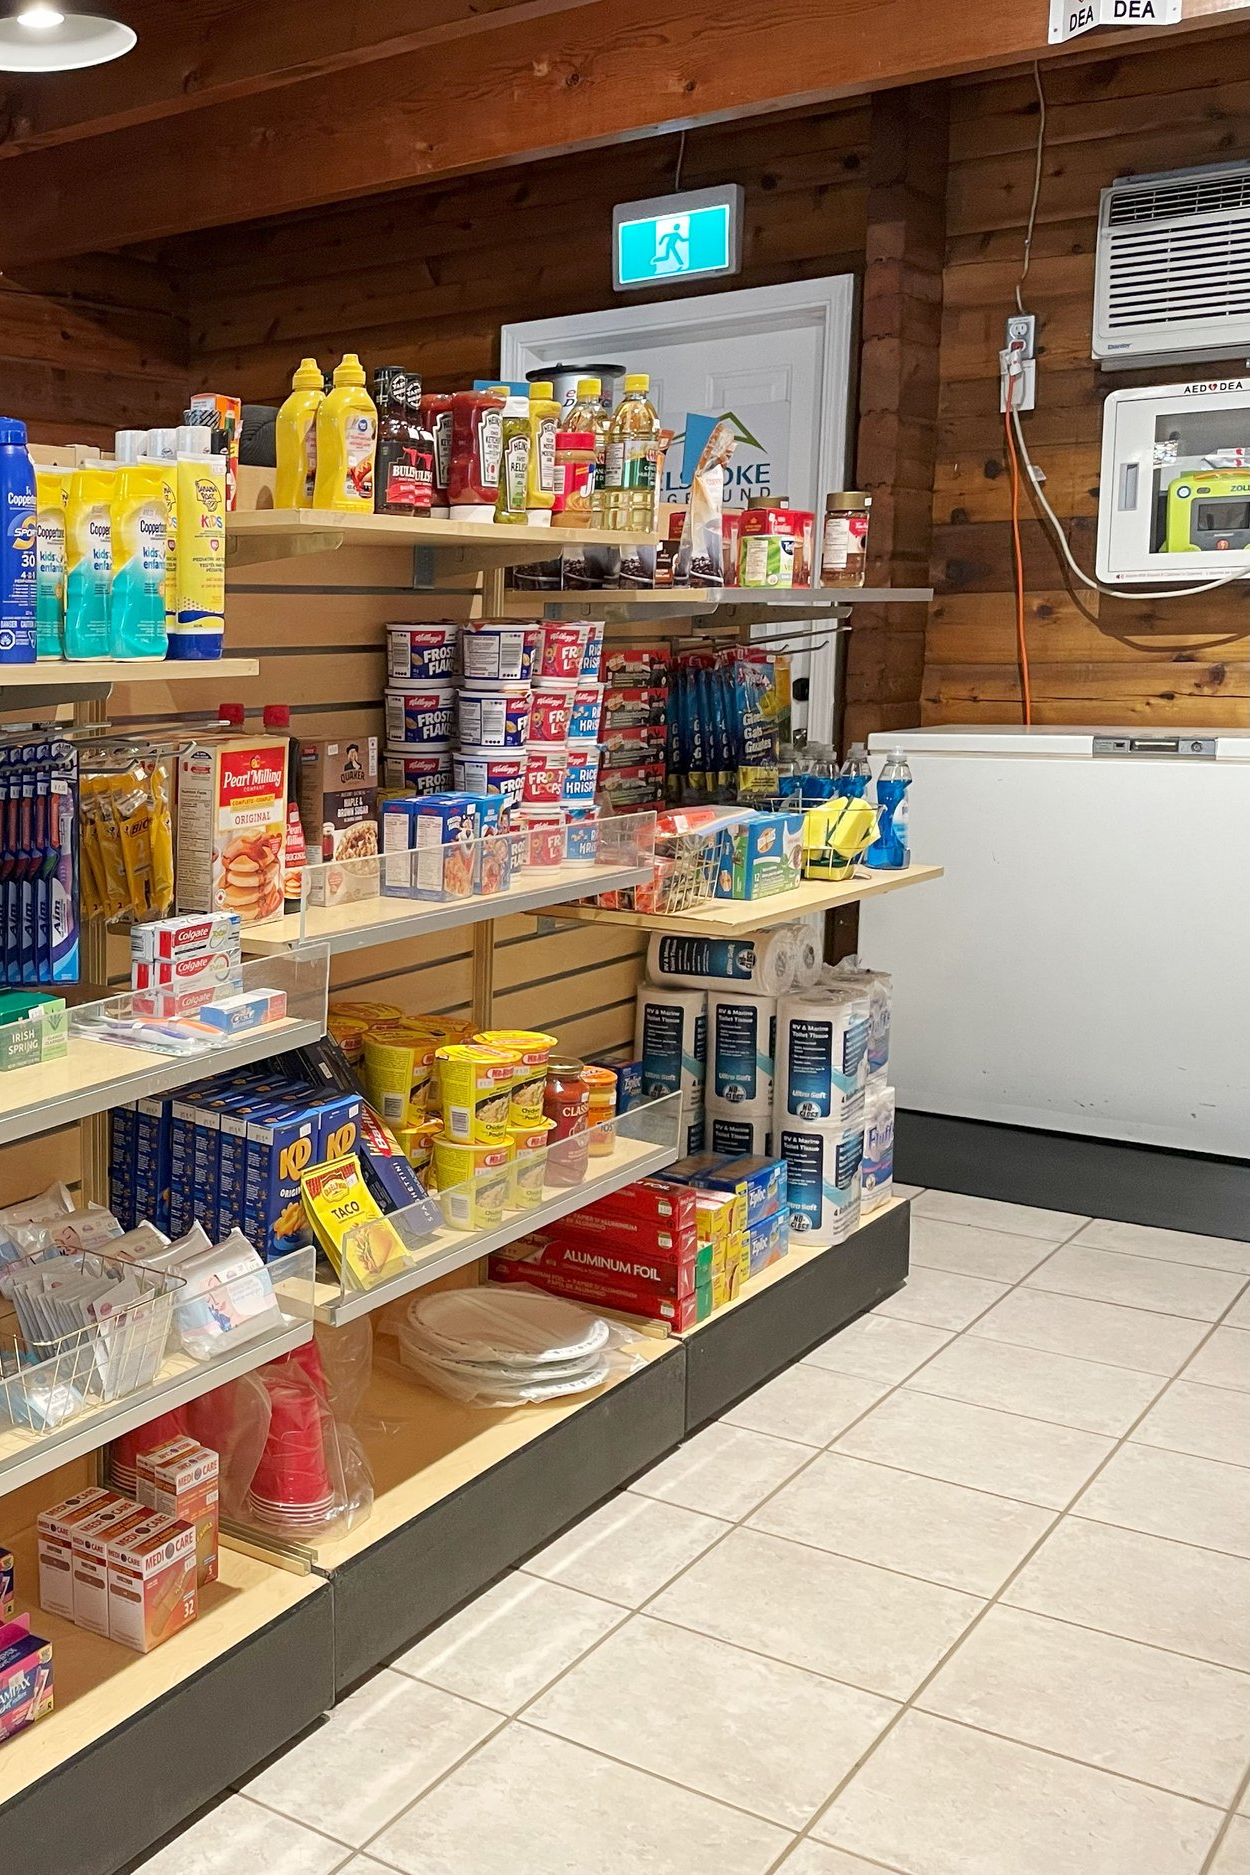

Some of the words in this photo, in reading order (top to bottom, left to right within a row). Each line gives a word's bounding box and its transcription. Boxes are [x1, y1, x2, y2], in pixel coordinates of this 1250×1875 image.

[1069, 6, 1094, 32] DEA
[1114, 0, 1155, 18] DEA
[1184, 384, 1207, 394] AED
[1220, 381, 1243, 391] DEA
[40, 551, 55, 561] kids
[93, 549, 109, 560] kids
[143, 547, 159, 559] kids
[21, 554, 35, 567] 30
[415, 633, 442, 643] Kellogg's
[550, 632, 577, 643] Kellogg's
[409, 699, 436, 709] Kellogg's
[537, 696, 563, 706] Kellogg's
[492, 764, 519, 774] Kellogg's
[223, 770, 250, 788] Pearl
[252, 768, 281, 787] Milling
[341, 771, 365, 783] QUAKER
[235, 812, 270, 825] ORIGINAL
[131, 818, 149, 837] BIC
[53, 900, 62, 934] Aim
[178, 927, 209, 941] Colgate
[178, 958, 208, 972] Colgate
[182, 992, 211, 1007] Colgate
[718, 1015, 733, 1023] Toilet
[12, 1030, 35, 1044] IRISH
[8, 1040, 38, 1056] SPRING
[735, 1074, 751, 1082] Soft
[809, 1091, 827, 1099] Soft
[327, 1123, 356, 1160] KD
[784, 1142, 799, 1150] Toilet
[280, 1137, 312, 1182] KD
[331, 1201, 360, 1220] TACO
[564, 1250, 630, 1273] ALUMINUM
[633, 1266, 661, 1281] FOIL
[178, 1474, 194, 1488] MEDI
[202, 1461, 217, 1475] CARE
[77, 1488, 99, 1501] CARE
[80, 1519, 102, 1533] MEDI
[112, 1502, 134, 1516] CARE
[115, 1533, 138, 1547] MEDI
[149, 1514, 170, 1528] CARE
[91, 1544, 104, 1554] CARE
[145, 1550, 165, 1571] MEDI
[175, 1532, 194, 1551] CARE
[128, 1557, 141, 1567] CARE
[184, 1600, 194, 1618] 32
